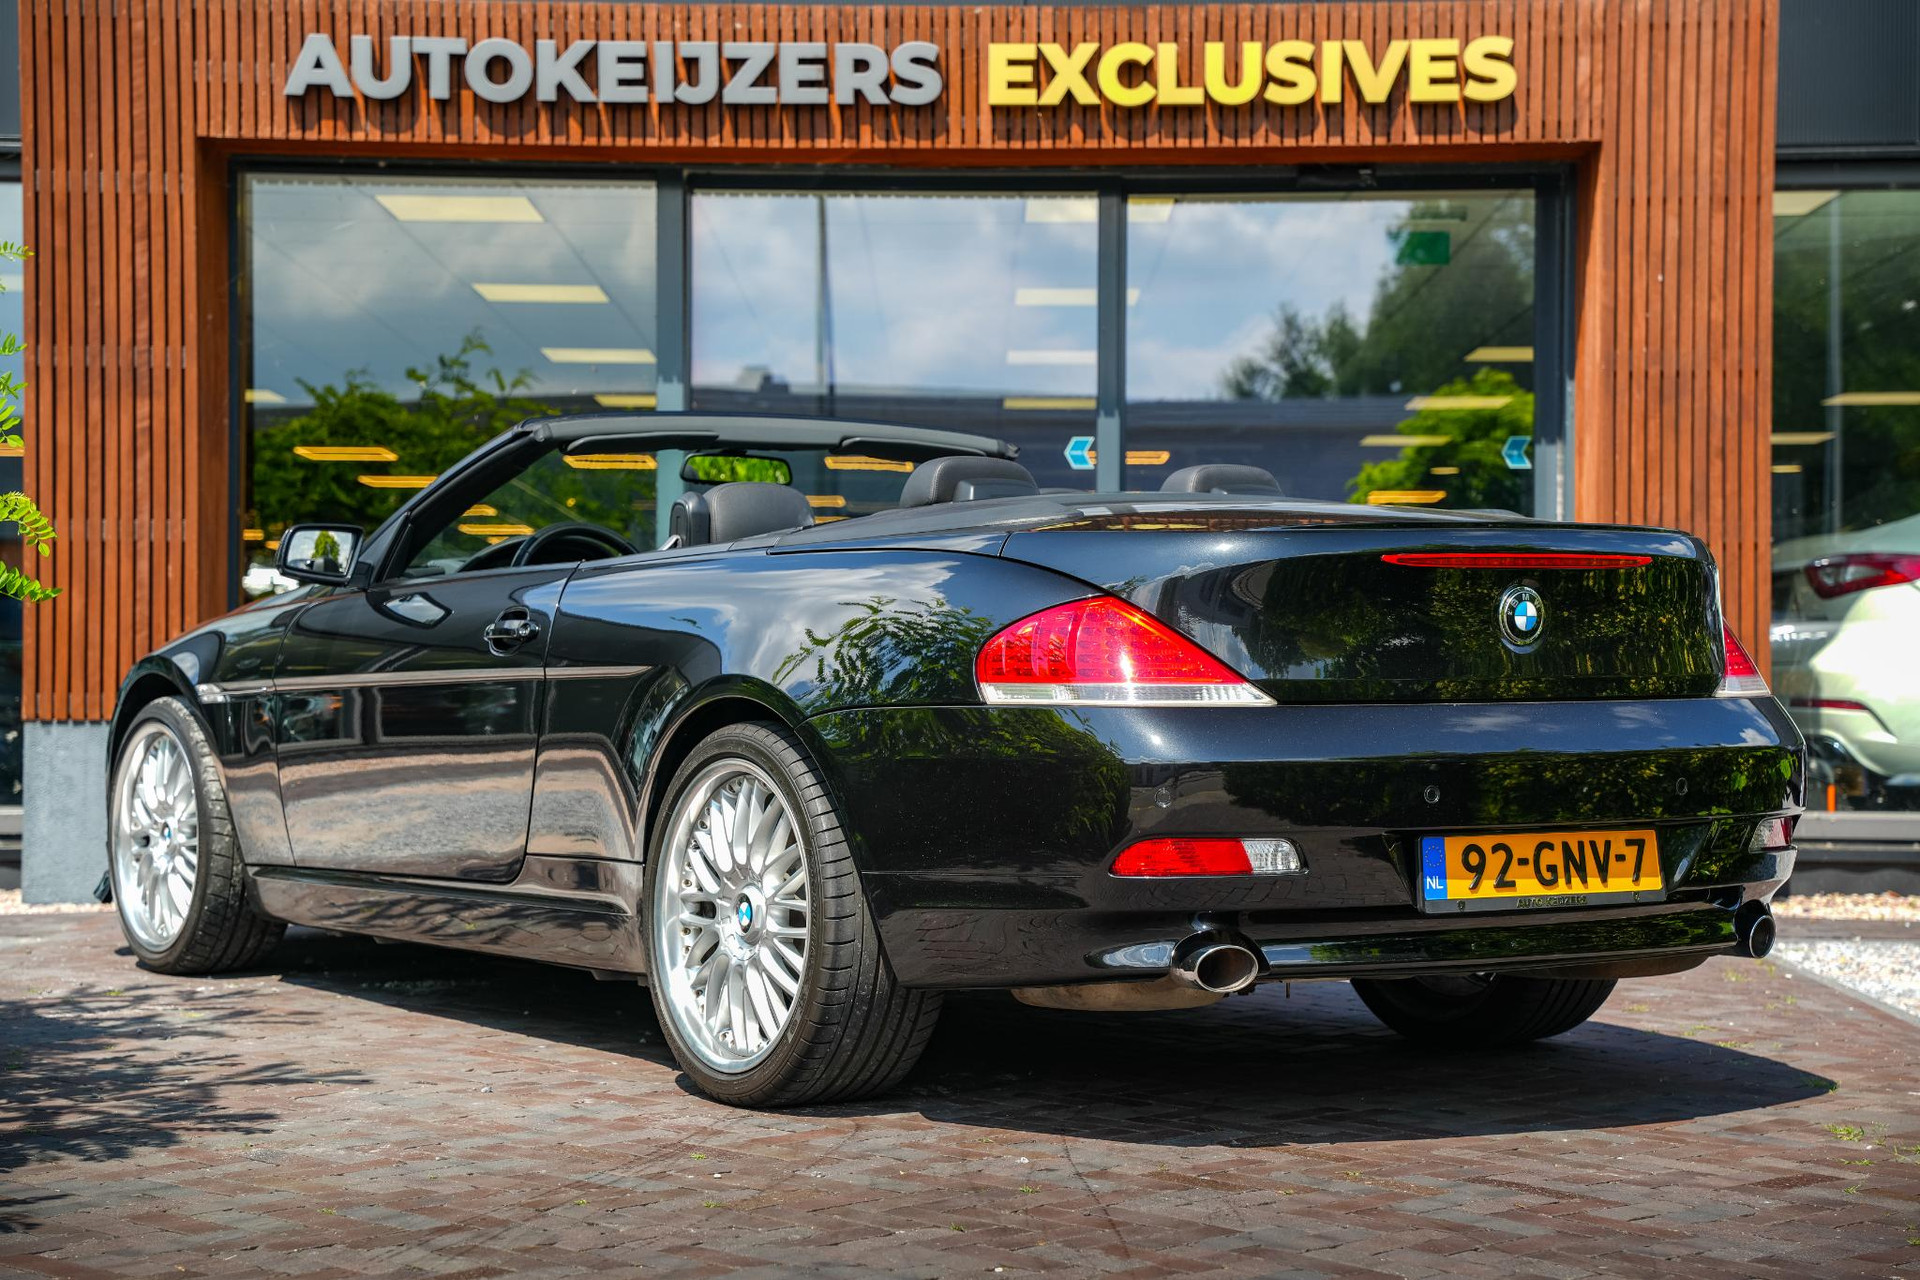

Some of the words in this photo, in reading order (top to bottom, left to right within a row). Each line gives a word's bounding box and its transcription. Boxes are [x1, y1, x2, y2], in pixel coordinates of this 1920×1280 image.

[284, 32, 943, 105] AUTOKEIJZERS
[988, 36, 1518, 106] EXCLUSIVES
[1426, 876, 1444, 890] NL
[1461, 838, 1646, 890] 92-GNV-7
